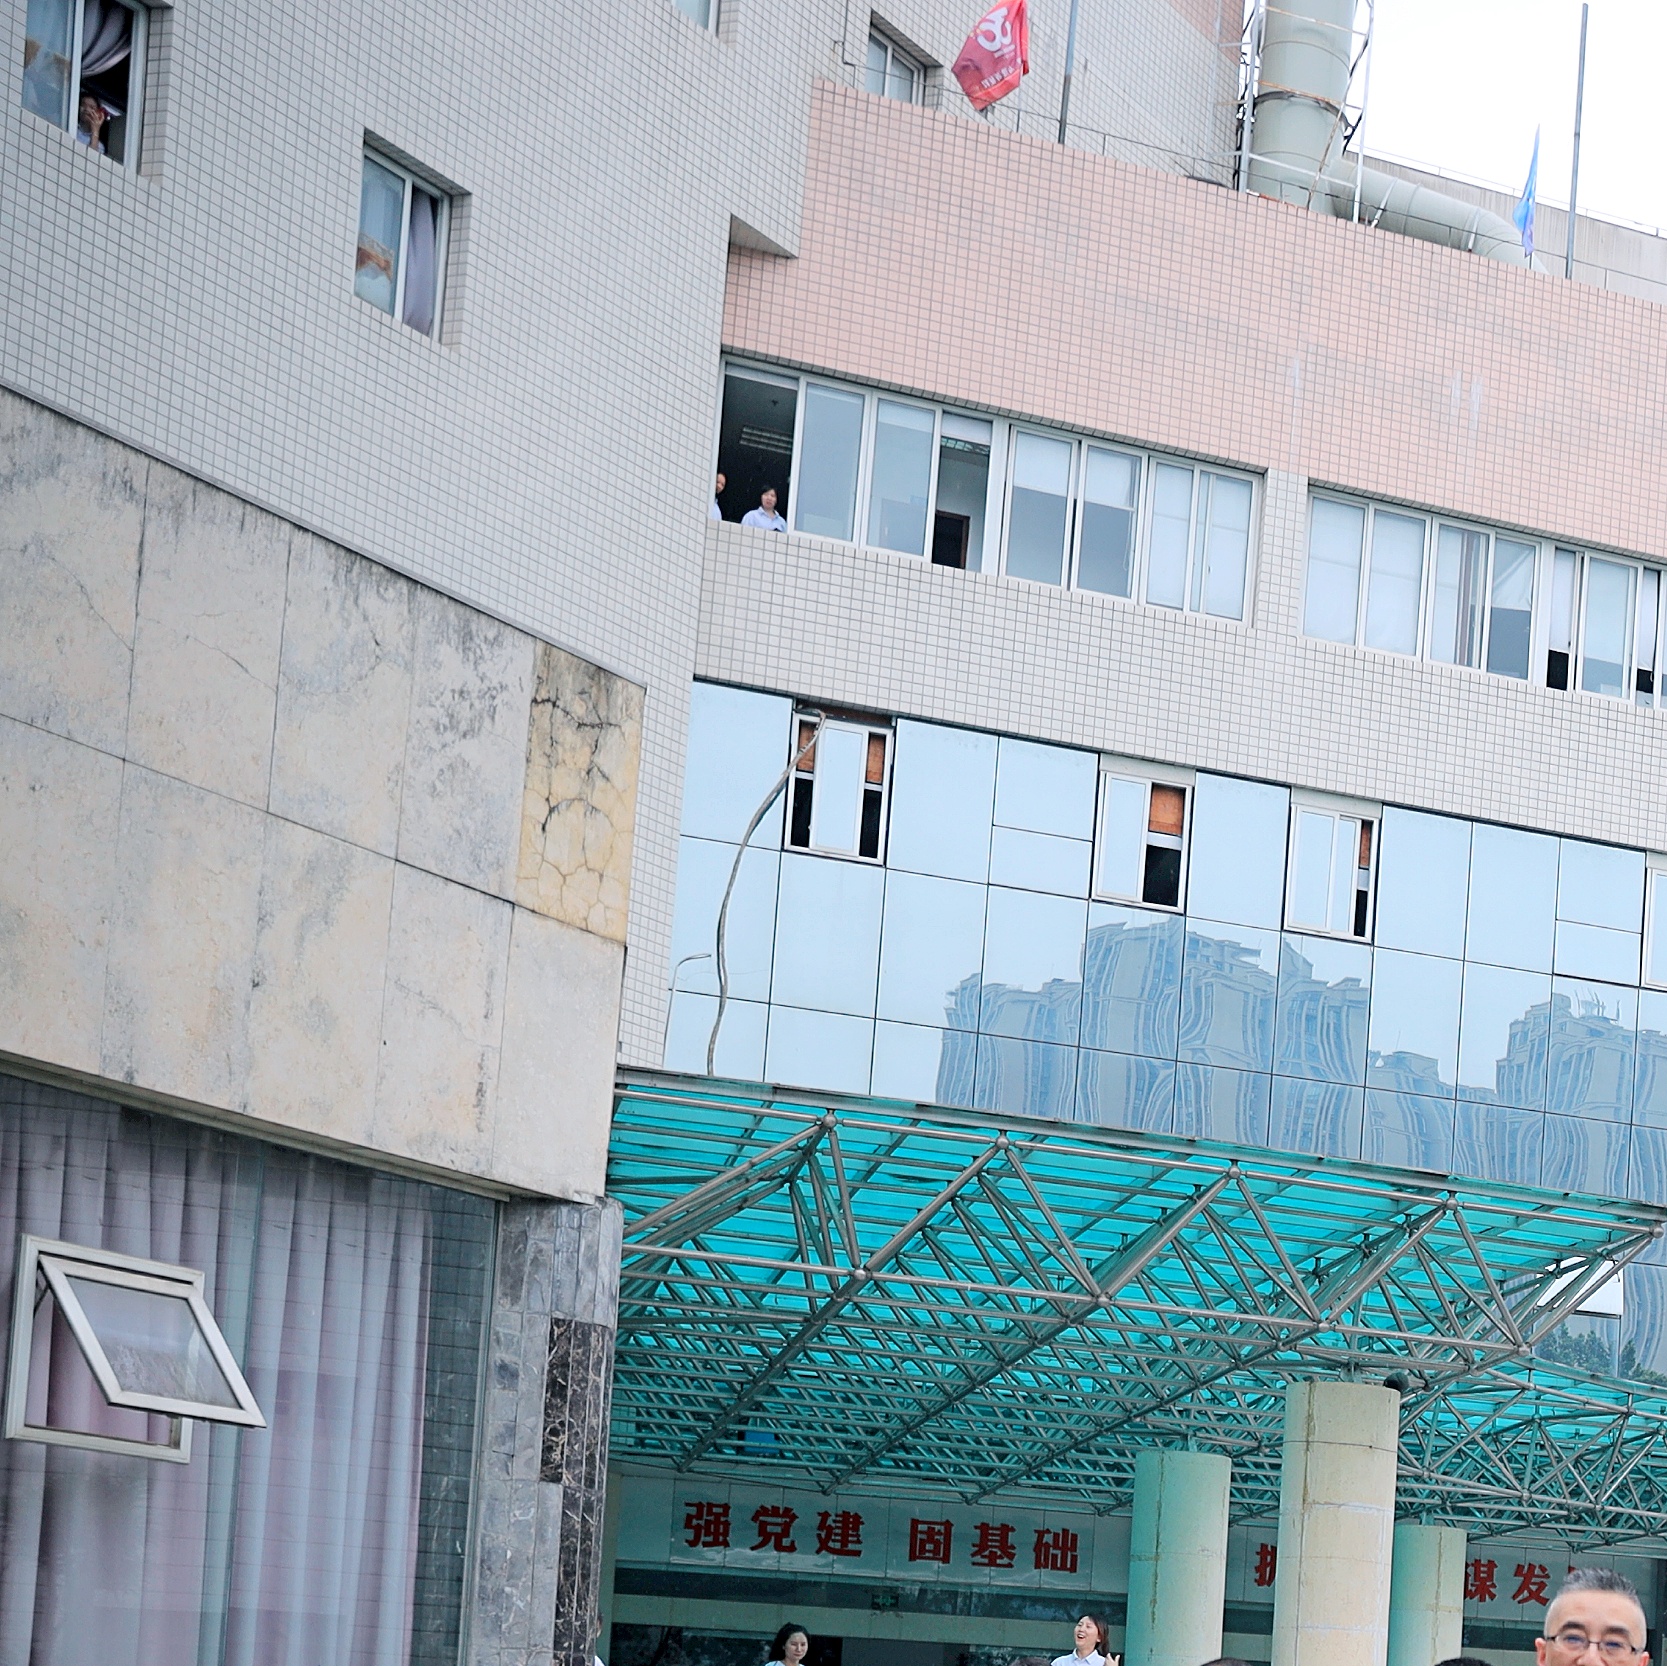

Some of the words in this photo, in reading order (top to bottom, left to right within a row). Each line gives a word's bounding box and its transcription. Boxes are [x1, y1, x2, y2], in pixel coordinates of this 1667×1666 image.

[684, 1501, 865, 1558] 强党建
[908, 1517, 1081, 1574] 固基础
[1464, 1558, 1577, 1607] 谋发
